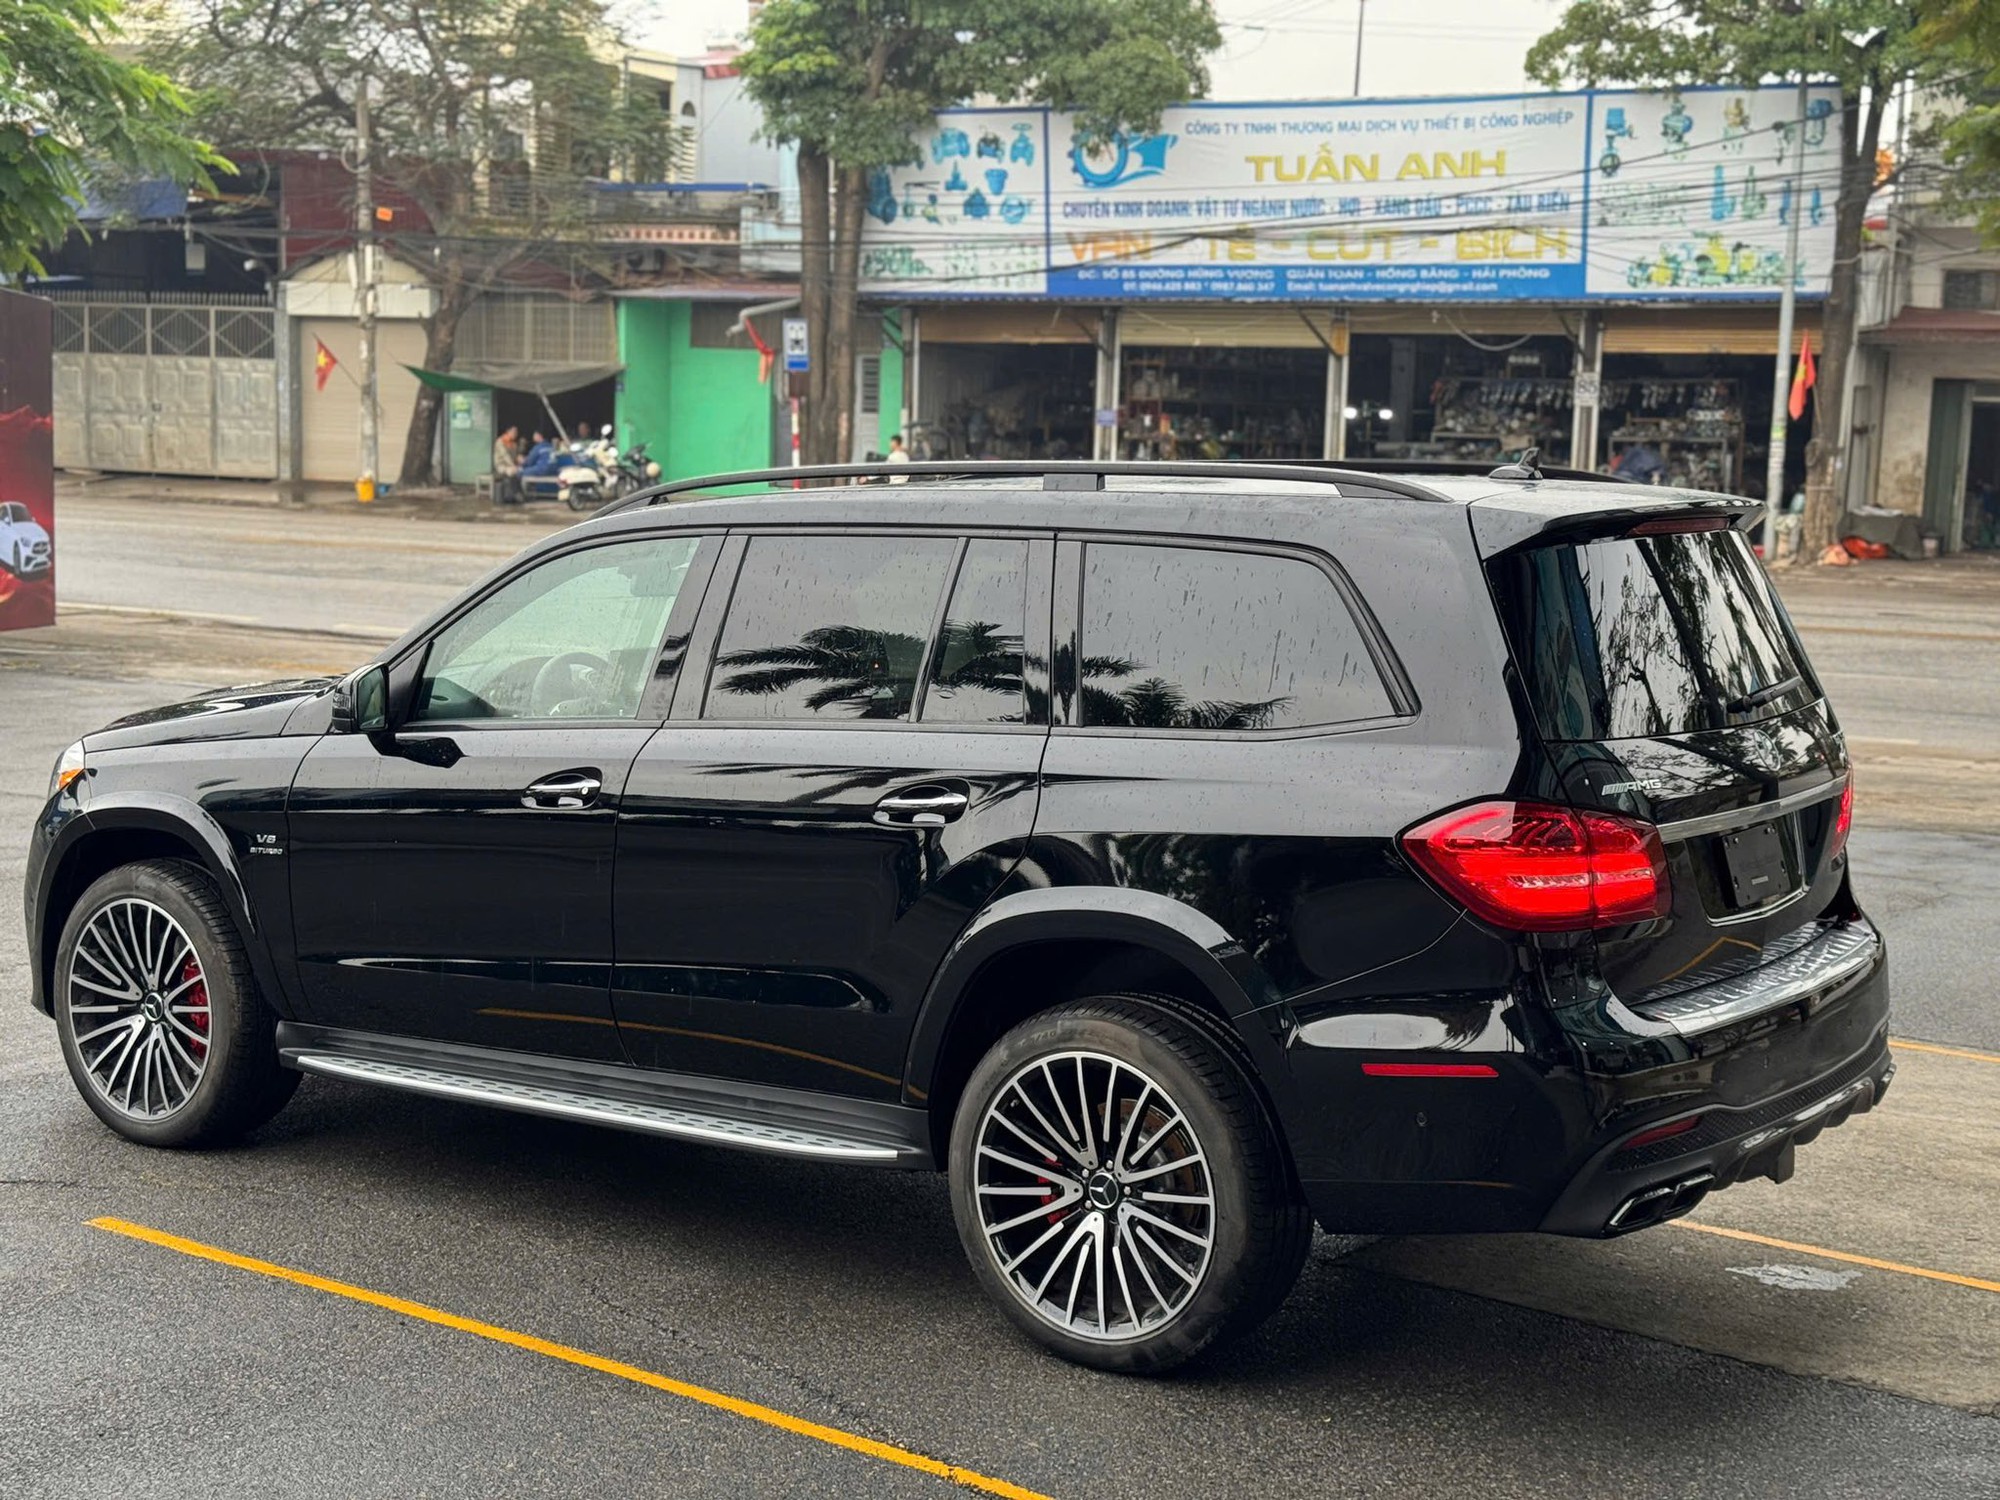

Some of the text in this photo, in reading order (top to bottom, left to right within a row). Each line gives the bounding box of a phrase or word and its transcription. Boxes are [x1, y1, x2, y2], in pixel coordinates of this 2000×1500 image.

[1185, 119, 1221, 135] CÔNG
[1224, 123, 1239, 134] TY
[1244, 122, 1277, 134] TNHH
[1337, 120, 1362, 137] MẠI
[1366, 119, 1397, 137] DỊCH
[1401, 118, 1418, 136] VỤ
[1424, 112, 1459, 131] THIẾT
[1464, 116, 1476, 133] BỊ
[1480, 112, 1518, 129] CÔNG
[1523, 108, 1575, 129] NGHIỆP
[1396, 150, 1508, 181] ANH
[1063, 197, 1110, 219] CHUYÊN
[1113, 200, 1143, 218] KINH
[1196, 196, 1218, 220] VẬT
[1242, 195, 1286, 217] NGÀNH
[1456, 196, 1492, 215] PCCC
[1065, 230, 1152, 261] VAN
[1499, 266, 1551, 279] PHÒNG
